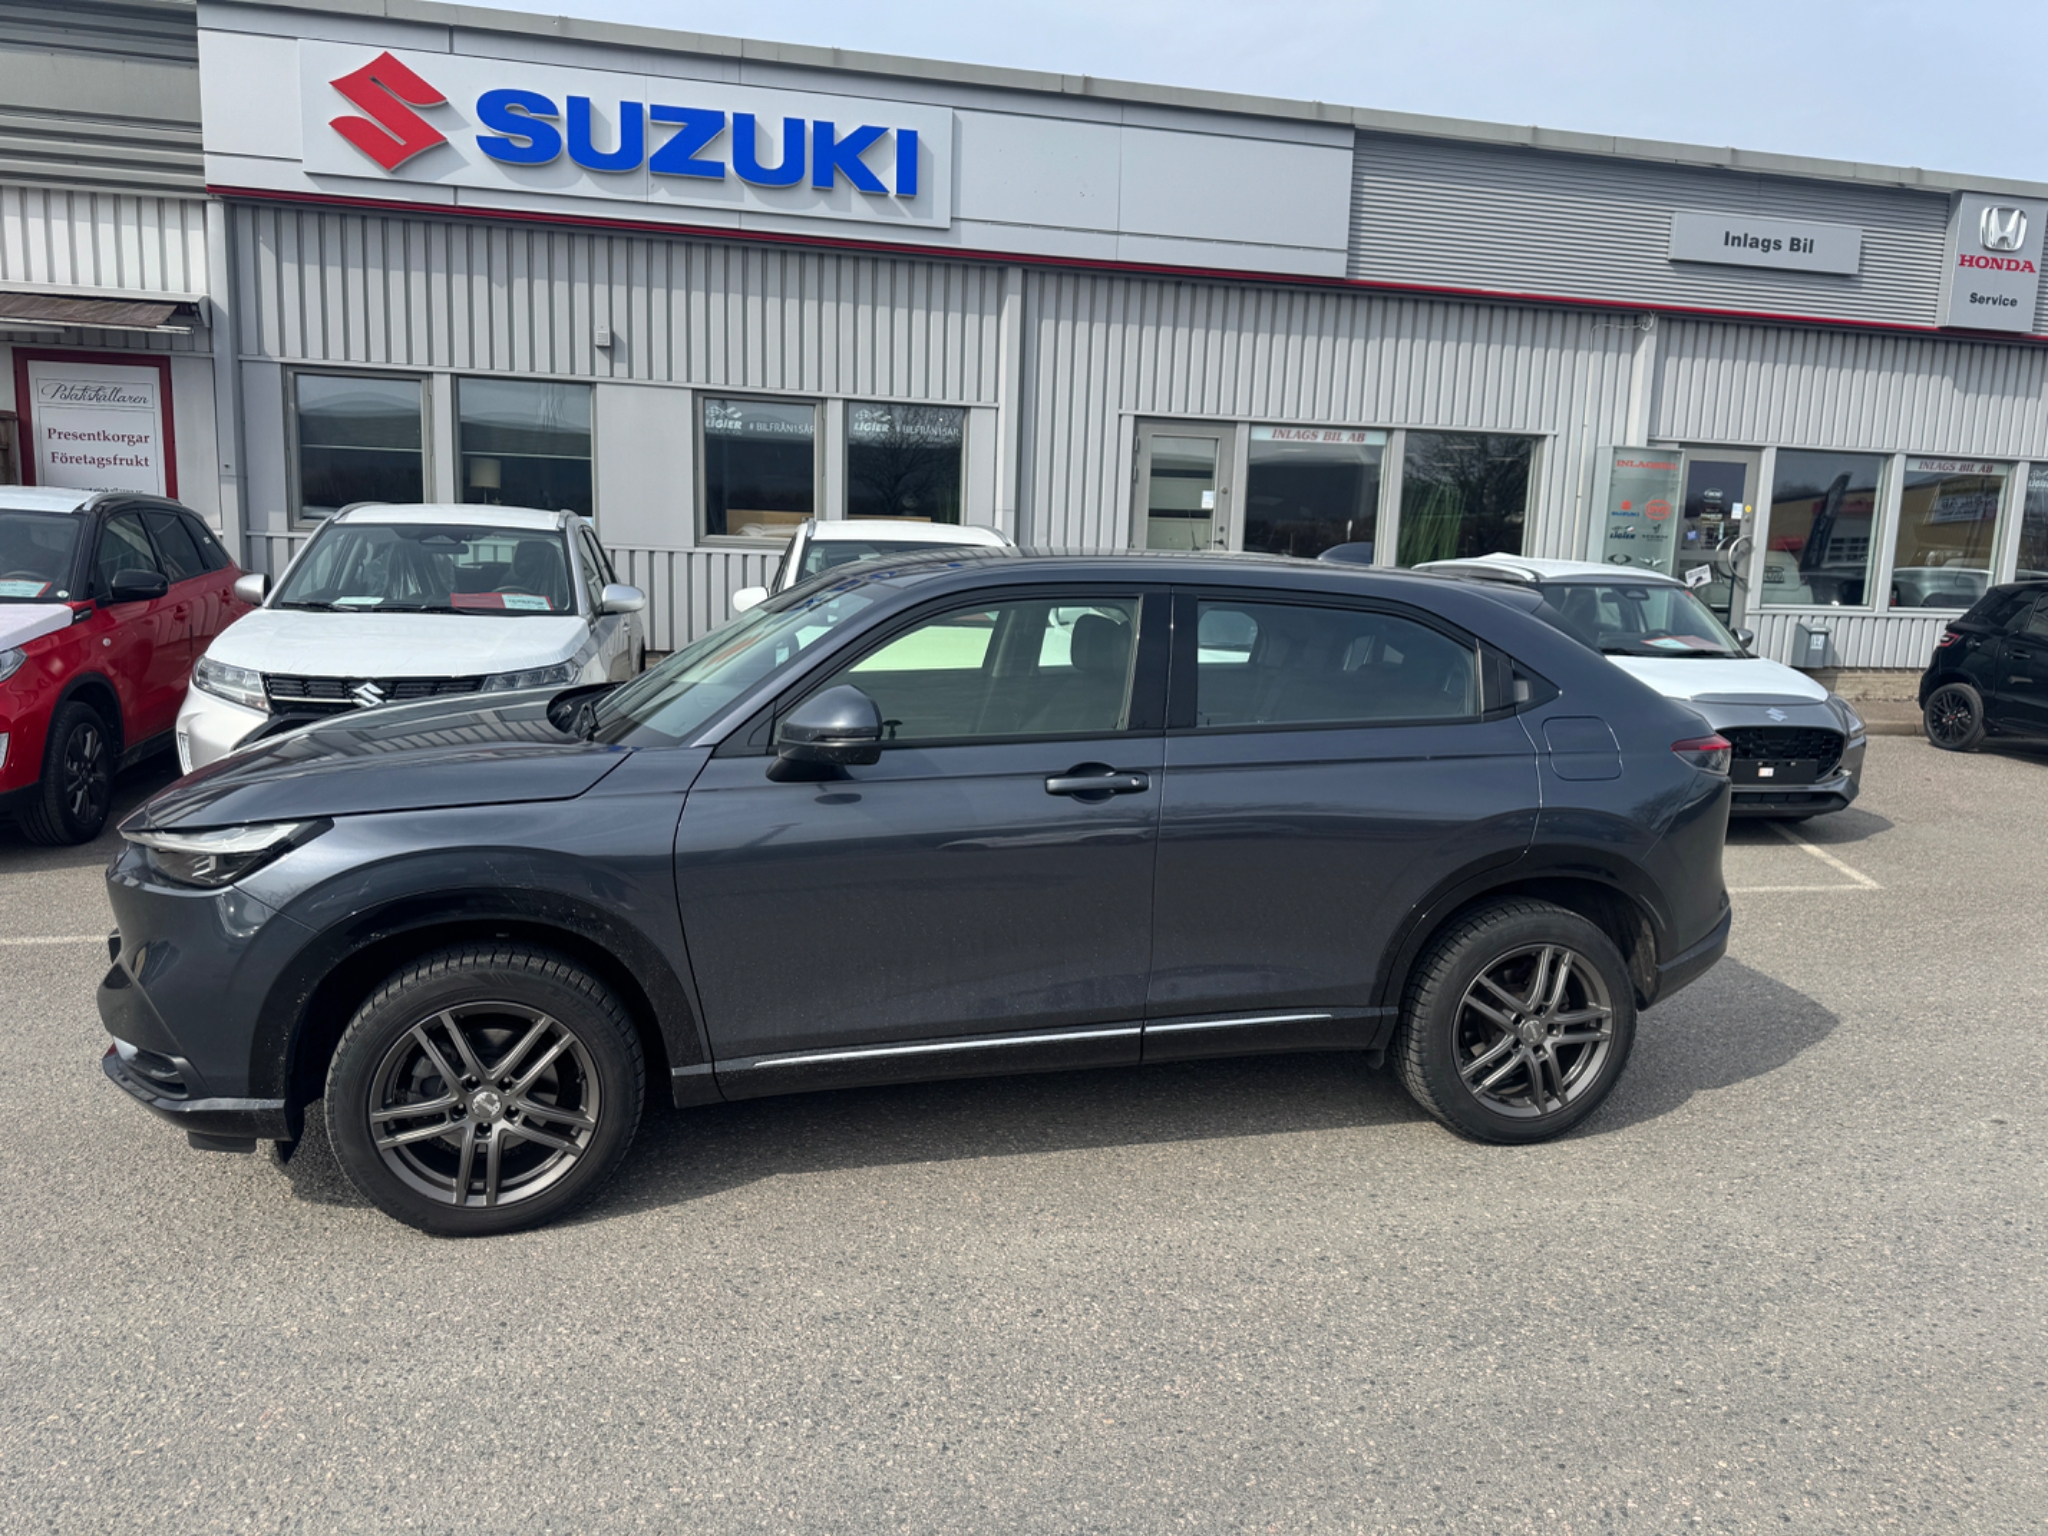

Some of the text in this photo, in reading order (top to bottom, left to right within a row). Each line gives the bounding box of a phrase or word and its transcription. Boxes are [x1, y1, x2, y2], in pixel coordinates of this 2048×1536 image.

[475, 88, 919, 198] SUZUKI
[1723, 231, 1815, 254] Inlags Bil
[1959, 254, 2036, 273] HONDA
[1969, 292, 2019, 307] Service
[47, 427, 150, 447] Presentkorgar
[1271, 428, 1366, 443] INLAGS BIL AB
[50, 451, 149, 469] Företagsfrukt
[1918, 460, 1994, 474] INLAGS BIL AB
